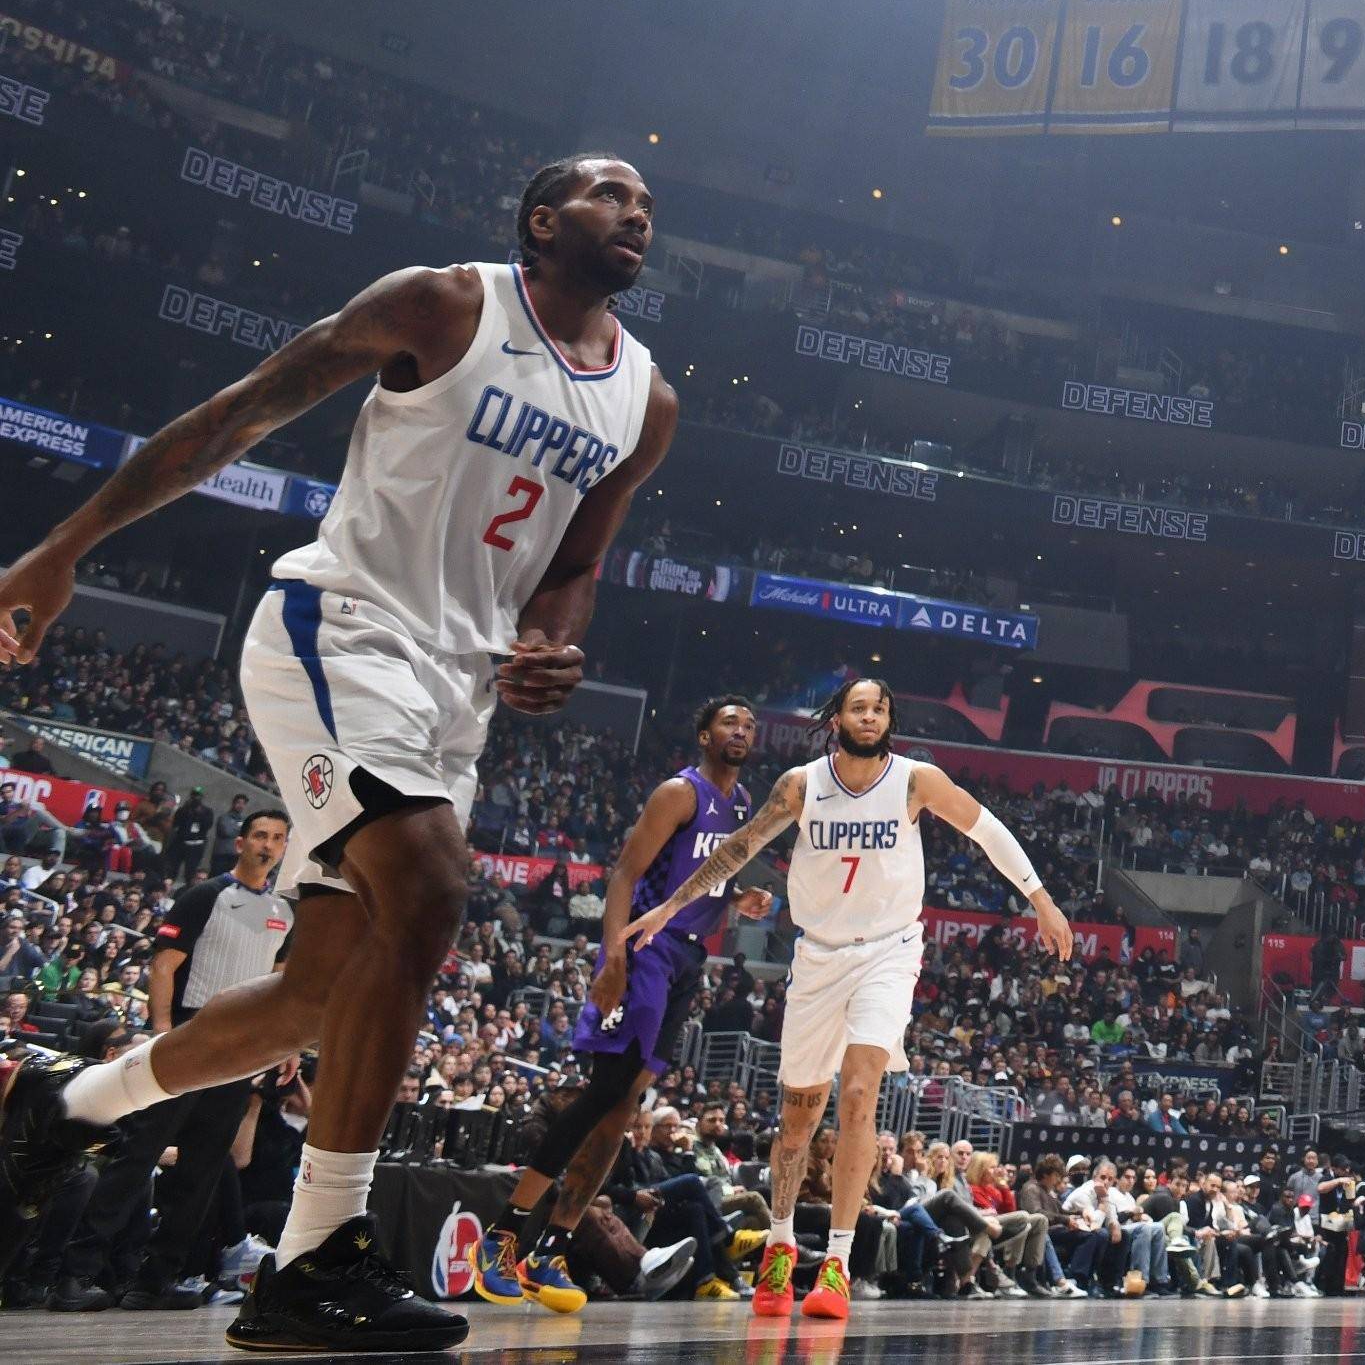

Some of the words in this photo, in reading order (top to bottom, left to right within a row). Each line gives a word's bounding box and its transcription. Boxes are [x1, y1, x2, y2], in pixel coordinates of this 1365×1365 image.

[949, 24, 1040, 91] 30
[1079, 23, 1151, 90] 16
[1203, 20, 1277, 86] 18
[180, 146, 358, 235] DEFENSE
[795, 324, 952, 385] DEFENSE
[1062, 380, 1214, 429] DEFENSE
[466, 384, 619, 495] CLIPPERS
[778, 443, 938, 502] DEFENSE
[482, 474, 545, 552] 2
[1053, 493, 1208, 542] DEFENSE
[834, 589, 891, 618] ULTRA
[941, 611, 1027, 642] DELTA
[809, 819, 899, 850] CLIPPERS
[840, 856, 861, 894] 7
